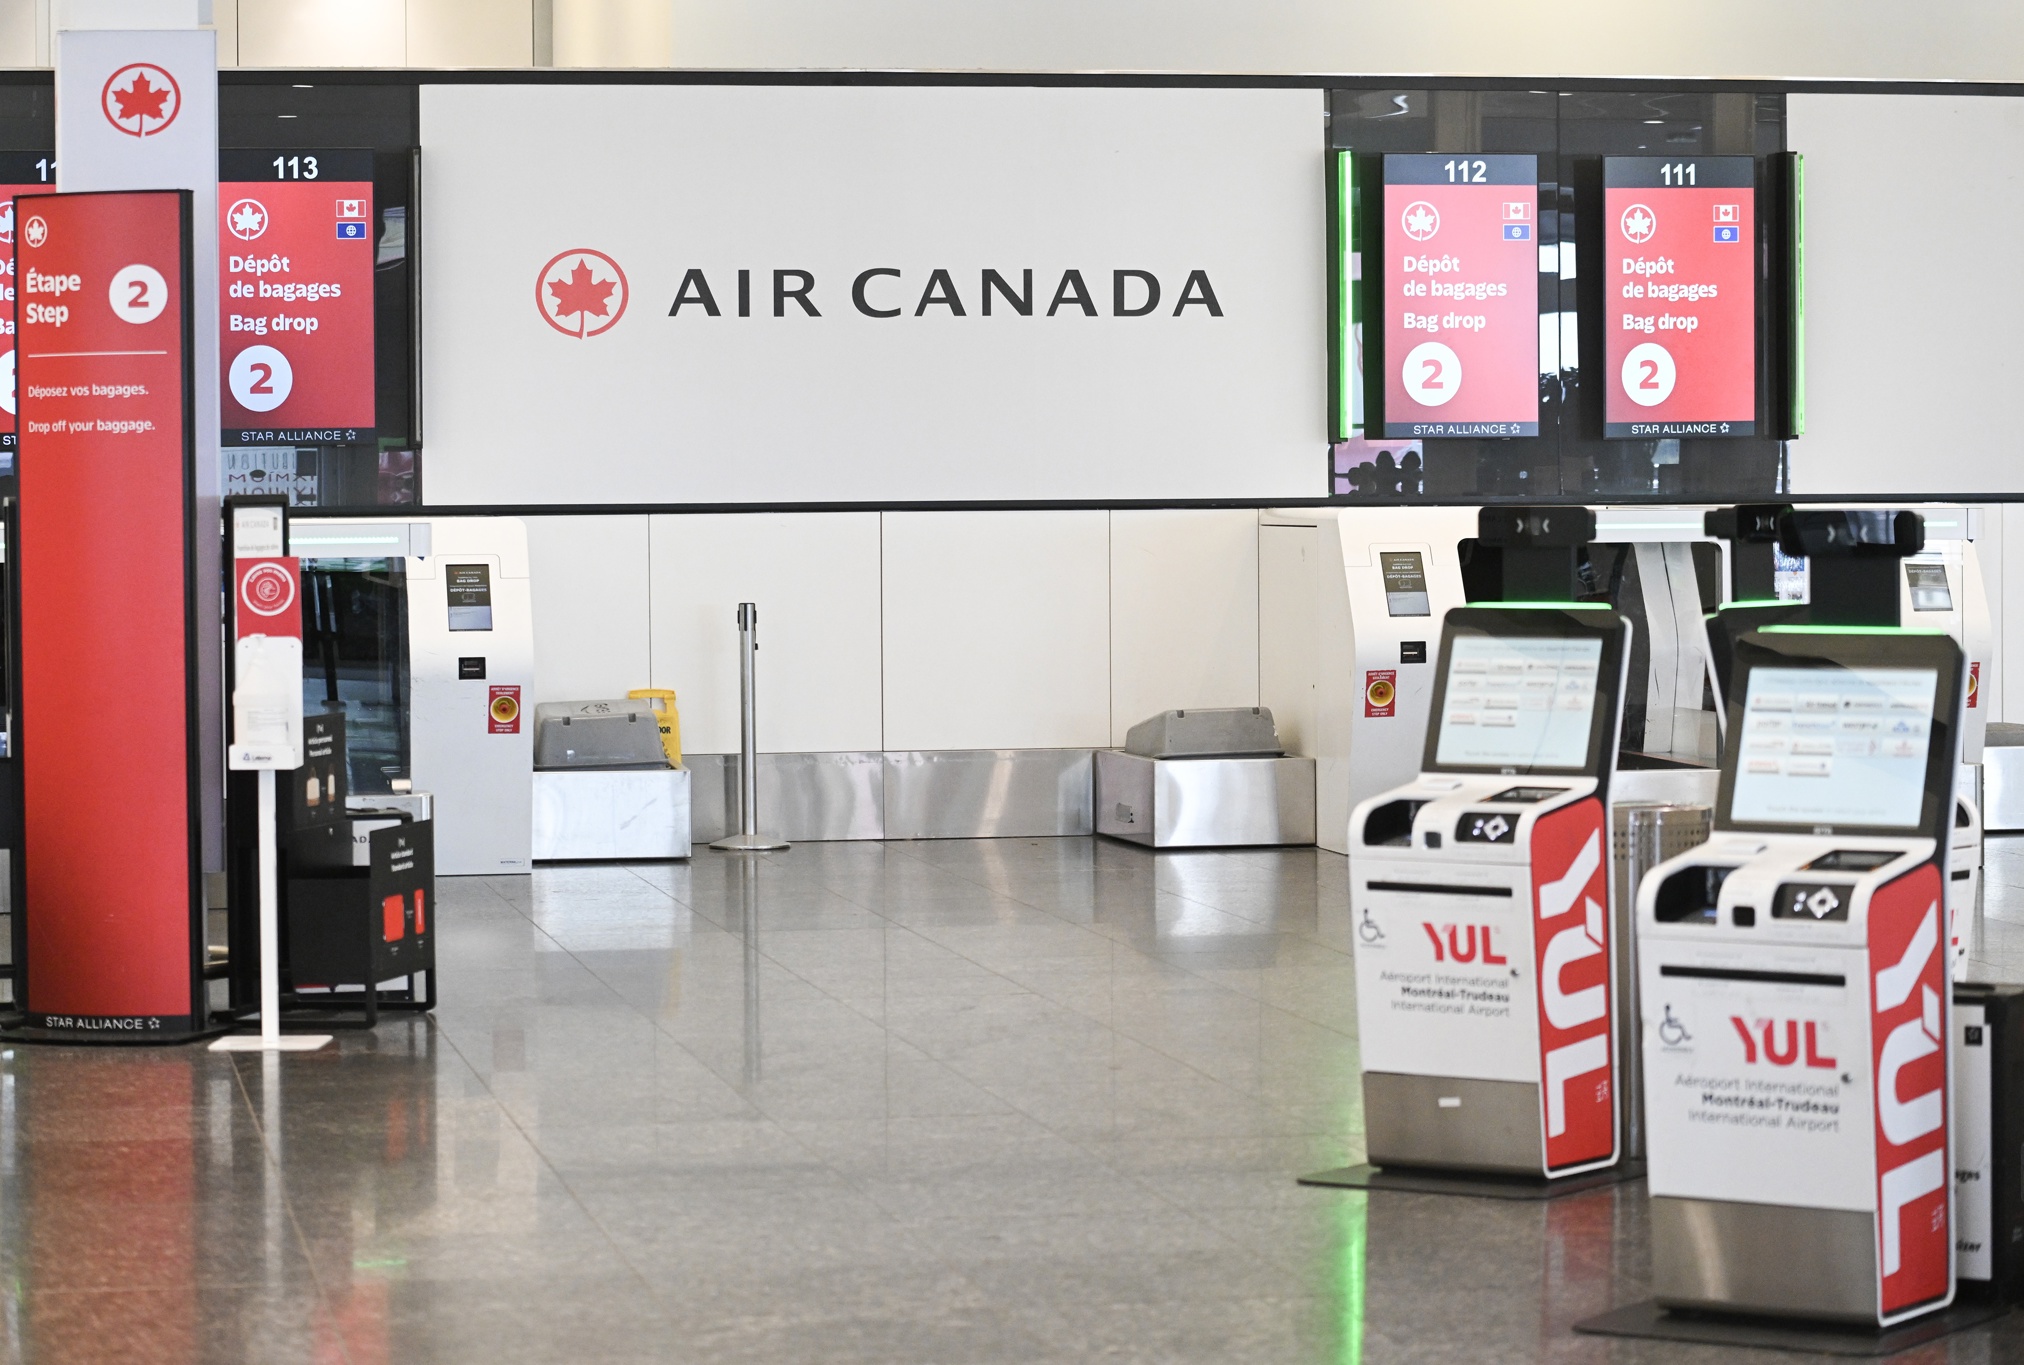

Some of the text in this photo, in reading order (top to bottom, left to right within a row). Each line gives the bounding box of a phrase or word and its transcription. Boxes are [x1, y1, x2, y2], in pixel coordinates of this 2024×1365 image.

[272, 156, 318, 180] 113
[1444, 160, 1487, 184] 112
[1660, 163, 1697, 186] 111
[229, 254, 290, 276] Dépôt
[1403, 254, 1460, 276] Dépôt
[1622, 256, 1674, 278] Dépôt
[26, 267, 81, 296] Étape
[229, 280, 342, 302] de bagages
[668, 267, 1224, 319] AIR CANADA
[1403, 279, 1508, 301] de bagages
[1622, 281, 1718, 302] de bagages
[128, 280, 149, 308] 2
[26, 302, 69, 328] Step
[230, 313, 319, 336] Bag drop
[1403, 311, 1487, 333] Bag drop
[1622, 312, 1699, 334] Bag drop
[249, 362, 274, 395] 2
[1421, 359, 1444, 390] 2
[1639, 359, 1660, 390] 2
[28, 383, 149, 400] Déposez vos bagages.
[28, 418, 156, 435] Drop off your baggage.
[241, 430, 341, 441] STAR ALLIANCE
[1413, 424, 1507, 435] STAR ALLIANCE
[1631, 423, 1717, 435] STAR ALLIANCE
[1421, 922, 1507, 965] YUL
[1380, 971, 1509, 989] Aéroport International
[1538, 826, 1608, 1138] YUL
[1401, 986, 1510, 1003] Montréal-Trudeau
[1390, 999, 1510, 1018] International Airport
[46, 1016, 143, 1030] STAR ALLIANCE
[1730, 1015, 1837, 1070] YUL
[1674, 1074, 1840, 1098] Aéroport International
[1876, 898, 1944, 1278] YUL
[1701, 1092, 1840, 1115] Montréal-Trudeau
[1688, 1108, 1840, 1133] International Airport
